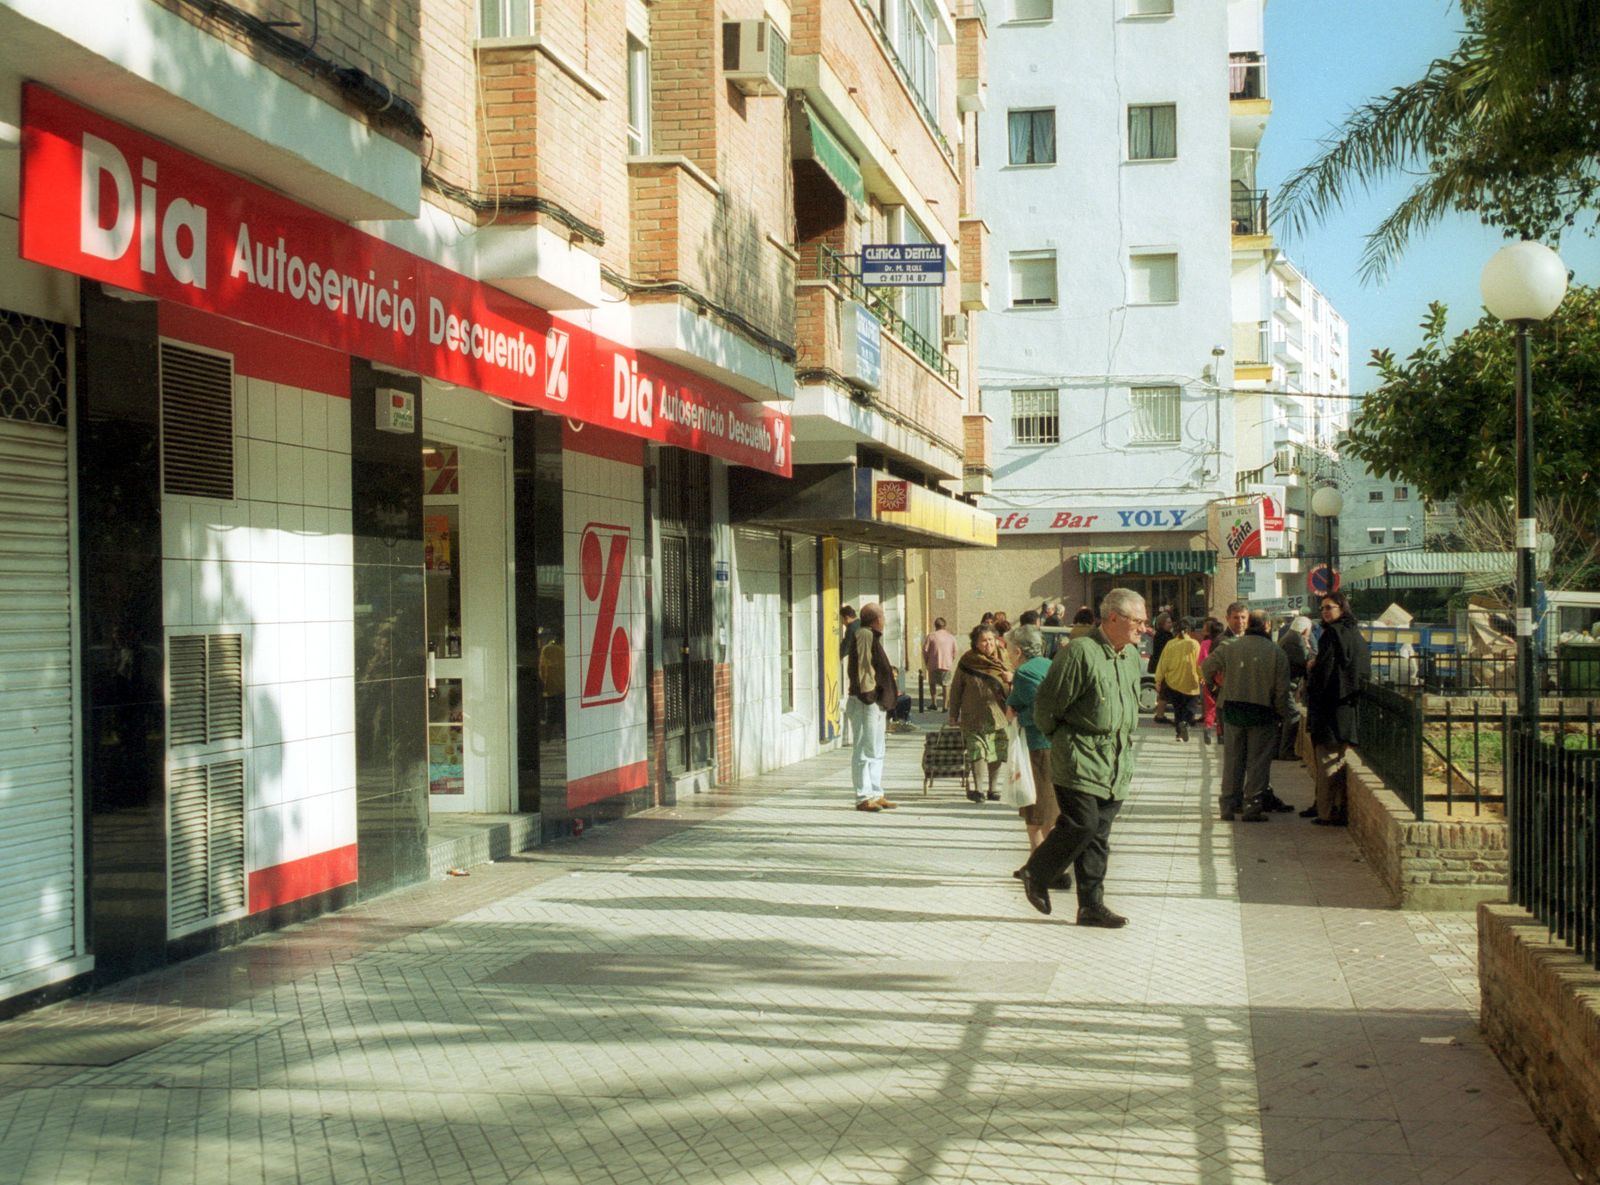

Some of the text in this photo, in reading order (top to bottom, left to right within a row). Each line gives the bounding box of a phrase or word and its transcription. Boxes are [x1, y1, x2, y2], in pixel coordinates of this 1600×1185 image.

[80, 131, 207, 289] Dia
[230, 222, 416, 337] Autoservicio
[429, 296, 536, 377] Descuento
[612, 352, 653, 428] Dia
[659, 385, 724, 438] Autoservicio
[728, 410, 771, 453] Descuento
[1049, 511, 1099, 529] Bar
[1117, 509, 1187, 527] YOLY
[1227, 520, 1253, 556] Fanta
